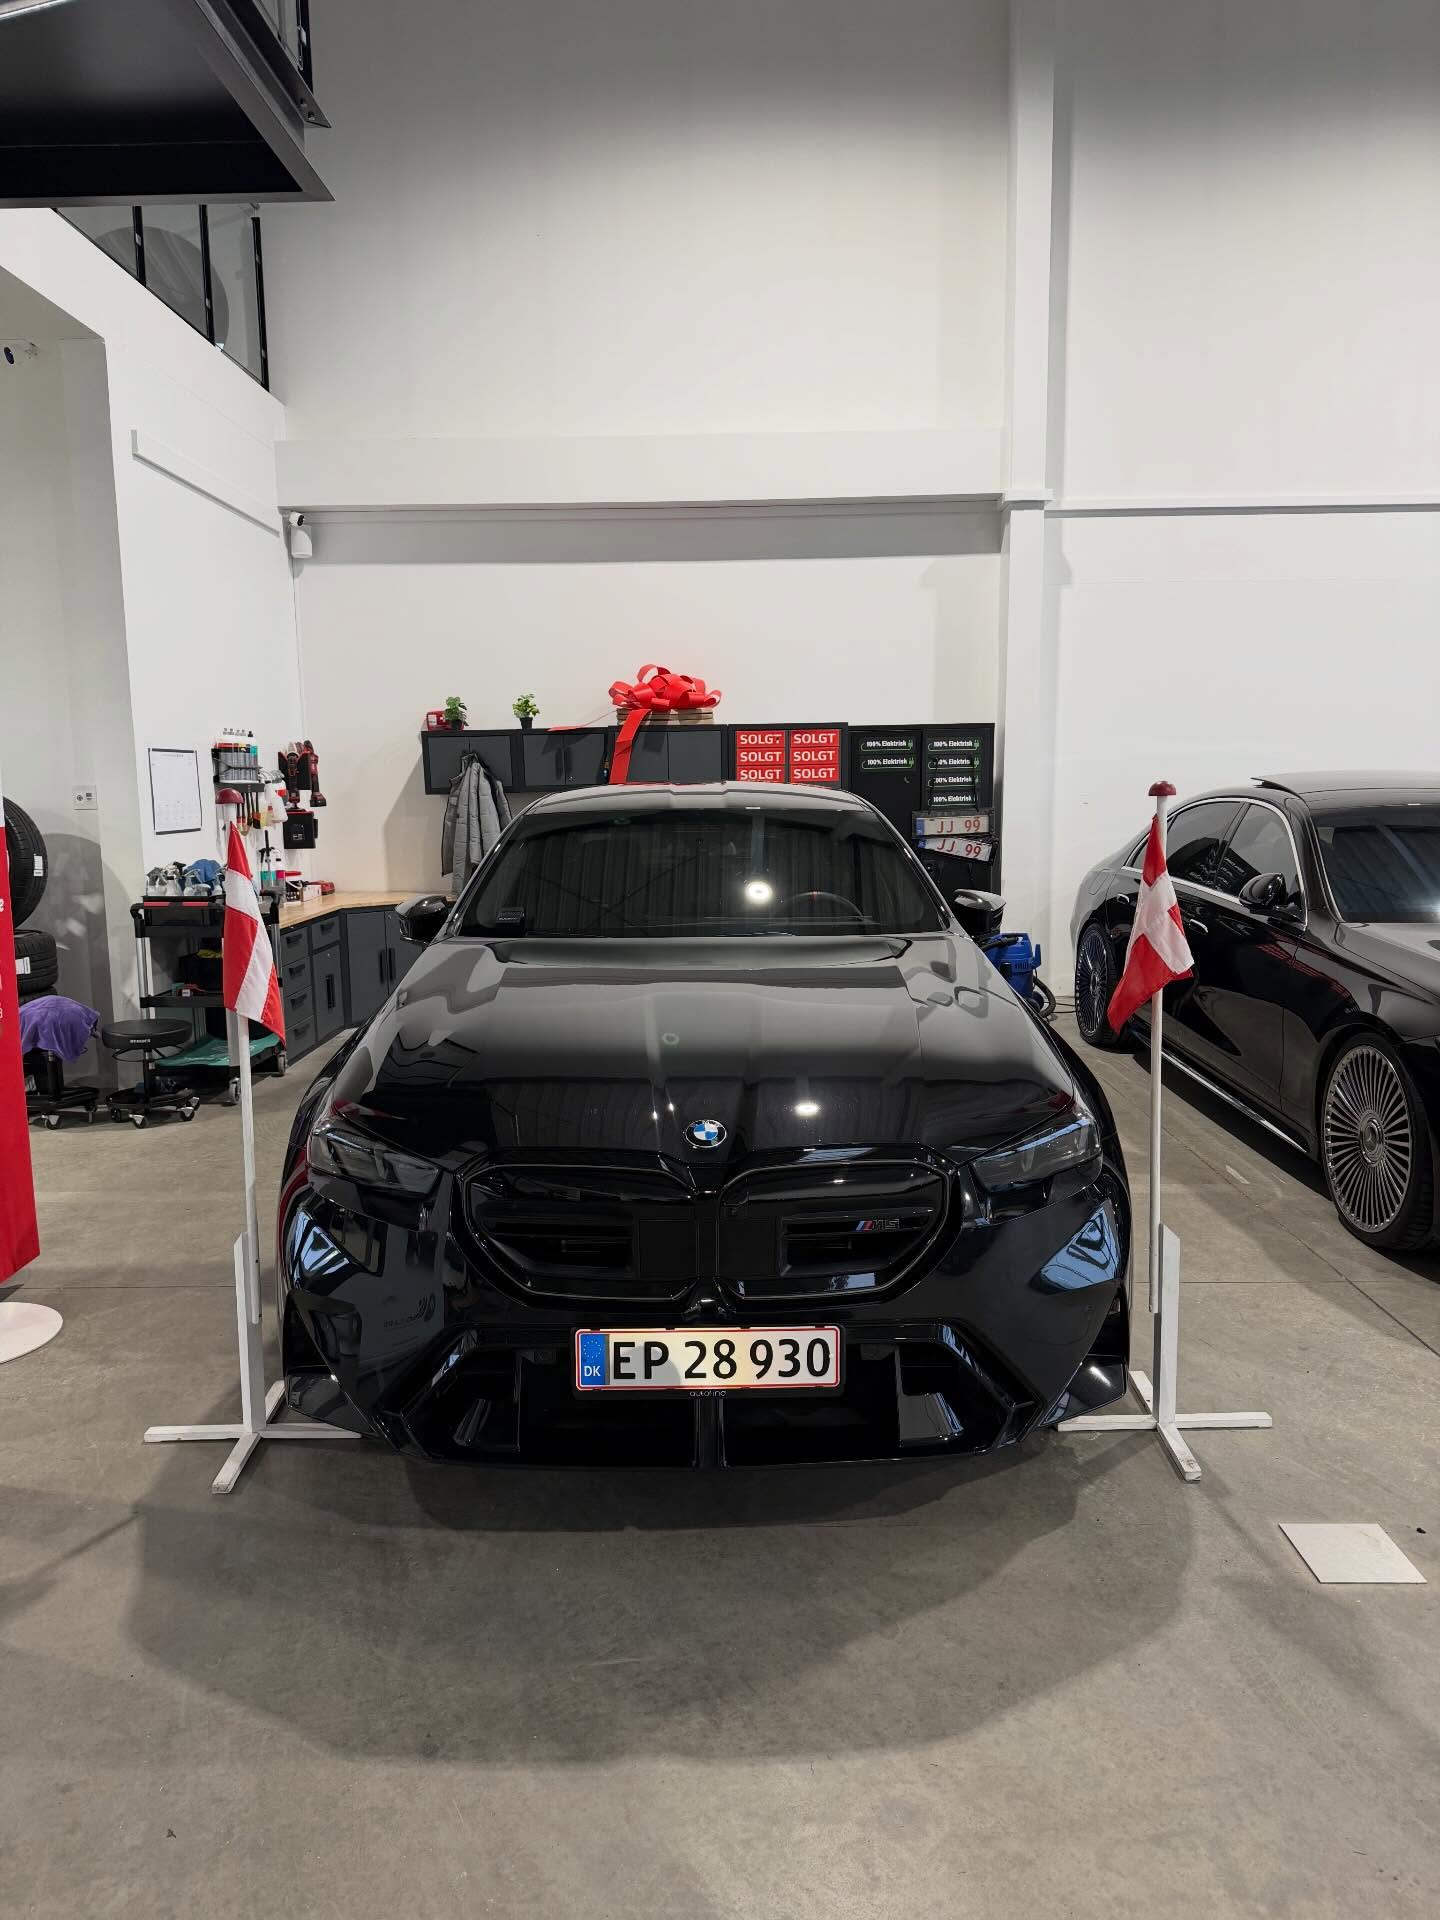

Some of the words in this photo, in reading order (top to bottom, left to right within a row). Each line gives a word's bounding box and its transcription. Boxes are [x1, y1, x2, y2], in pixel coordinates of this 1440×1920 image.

[740, 734, 782, 744] SOLGT
[793, 733, 836, 744] SOLGT
[740, 752, 782, 762] SOLGT
[793, 750, 836, 761] SOLGT
[740, 769, 782, 780] SOLGT
[793, 768, 836, 779] SOLGT
[964, 819, 981, 832] 99
[965, 844, 982, 857] 99
[613, 1341, 669, 1380] EP
[684, 1340, 737, 1380] 28
[750, 1337, 831, 1380] 930
[583, 1365, 601, 1377] DK
